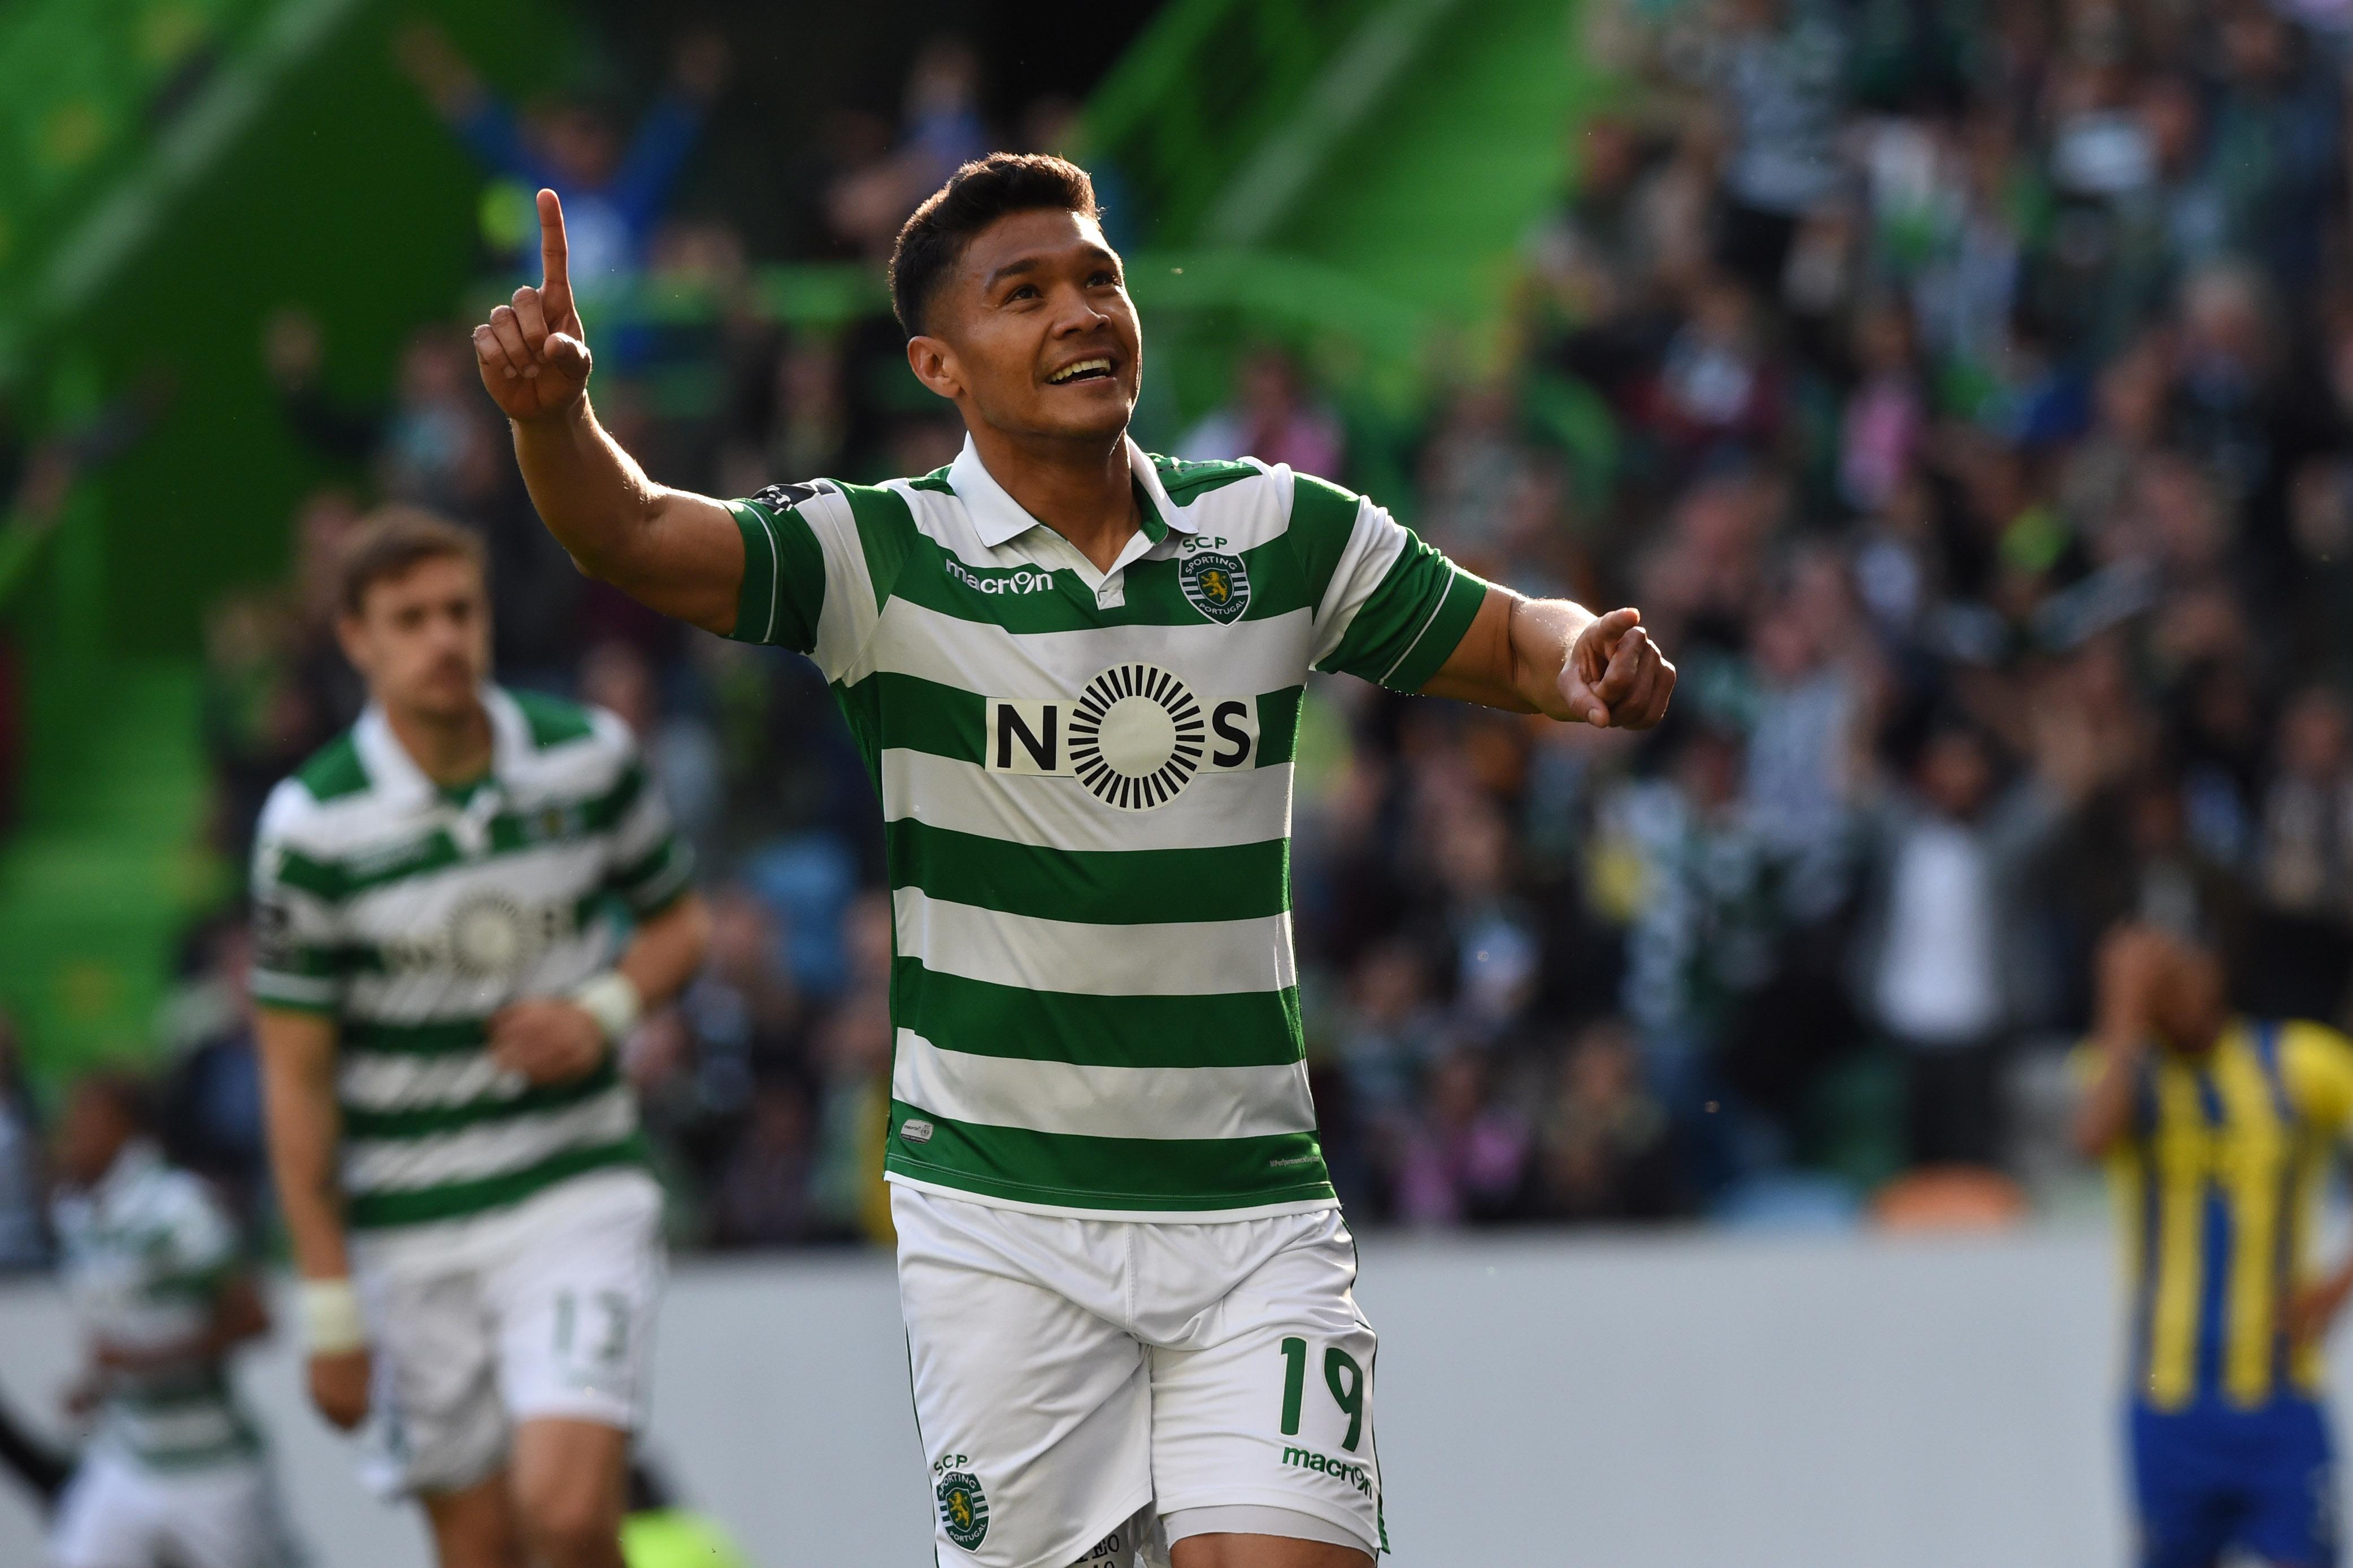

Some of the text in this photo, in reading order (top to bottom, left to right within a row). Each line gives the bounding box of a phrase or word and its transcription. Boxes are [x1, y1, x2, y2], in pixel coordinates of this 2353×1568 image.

[1182, 537, 1228, 552] SCP
[946, 558, 1054, 594] macron
[1185, 556, 1237, 574] SPORTING
[1199, 600, 1245, 615] PORTUGAL
[997, 664, 1251, 809] NOS
[1280, 1336, 1363, 1453] 19
[934, 1454, 968, 1476] SCP
[1282, 1446, 1372, 1500] macron
[939, 1473, 976, 1497] SPORTING
[950, 1523, 987, 1542] PORTUGAL
